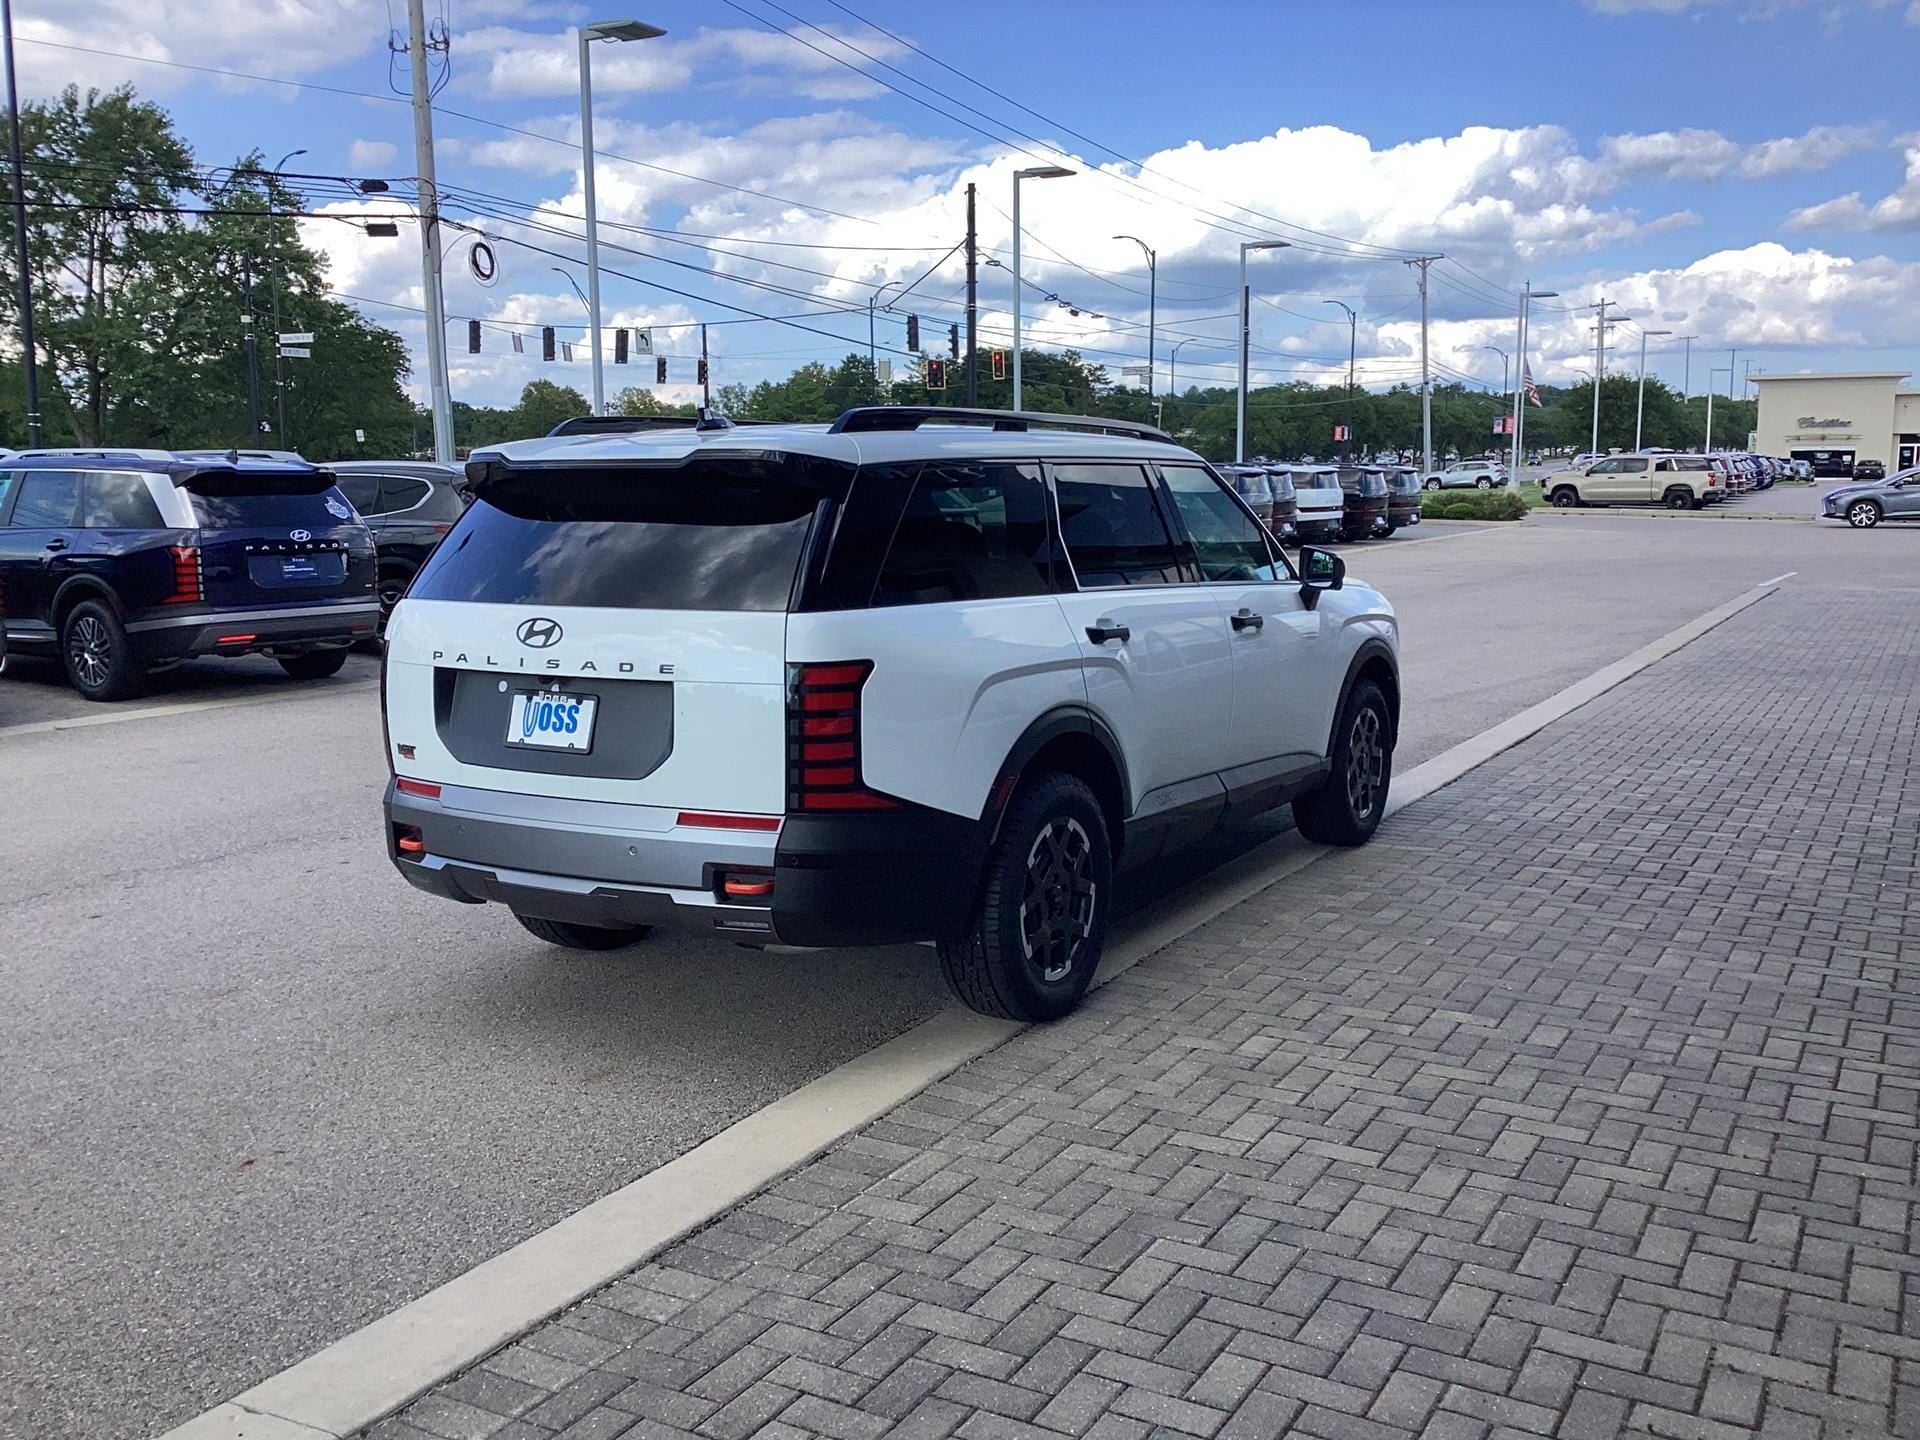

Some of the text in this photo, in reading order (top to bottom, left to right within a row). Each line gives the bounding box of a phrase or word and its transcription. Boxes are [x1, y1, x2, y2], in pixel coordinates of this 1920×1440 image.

[245, 542, 350, 551] PALISADE
[433, 651, 675, 674] PALISADE
[523, 701, 580, 737] VOSS
